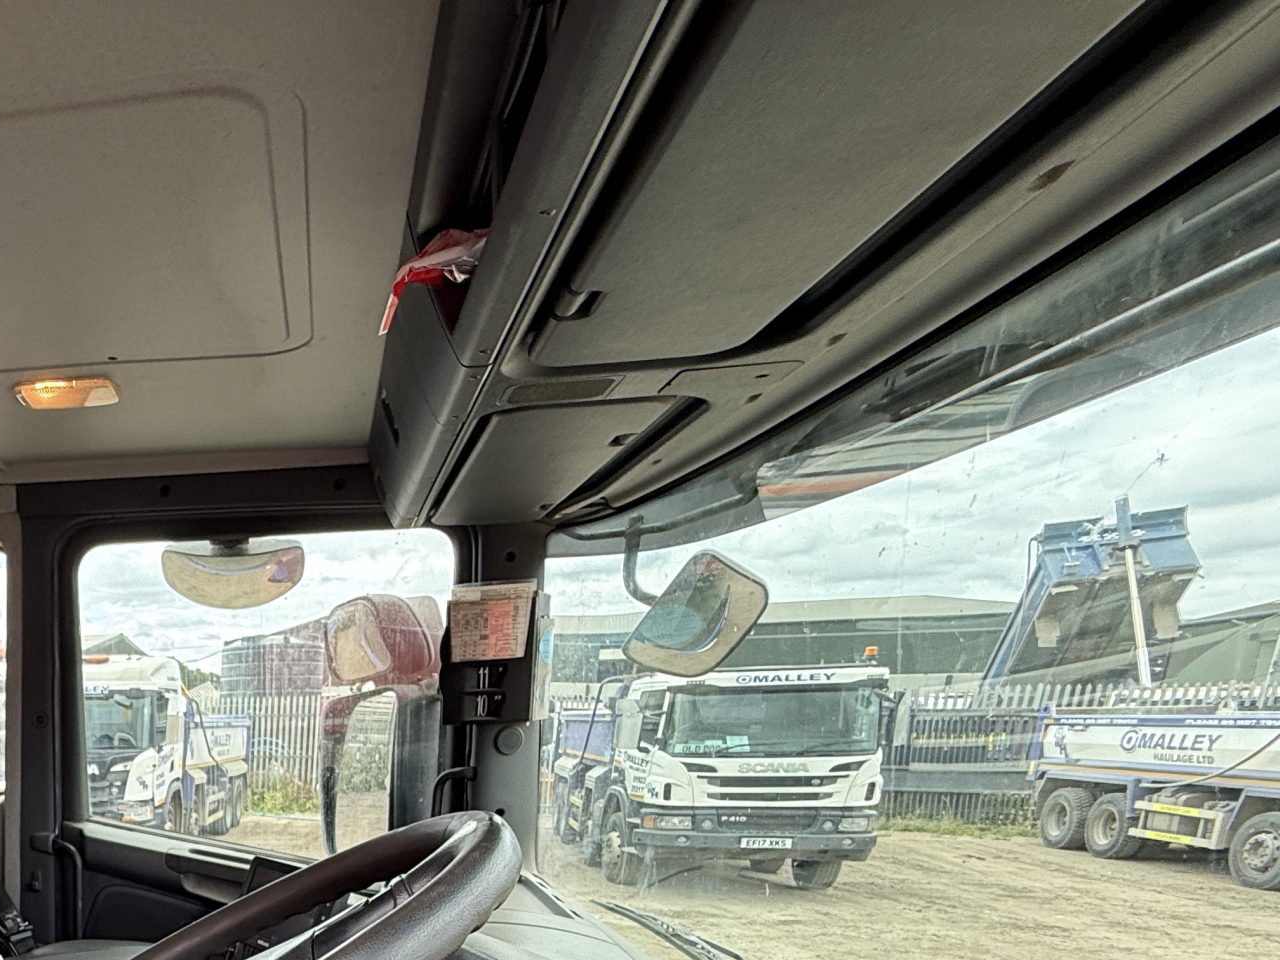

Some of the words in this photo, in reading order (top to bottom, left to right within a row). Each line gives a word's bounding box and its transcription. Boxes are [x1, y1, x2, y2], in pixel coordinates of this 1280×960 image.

[1153, 753, 1194, 763] HAULAGE
[1196, 756, 1214, 765] LTD
[737, 762, 809, 773] SCANIA
[746, 839, 766, 847] EF17
